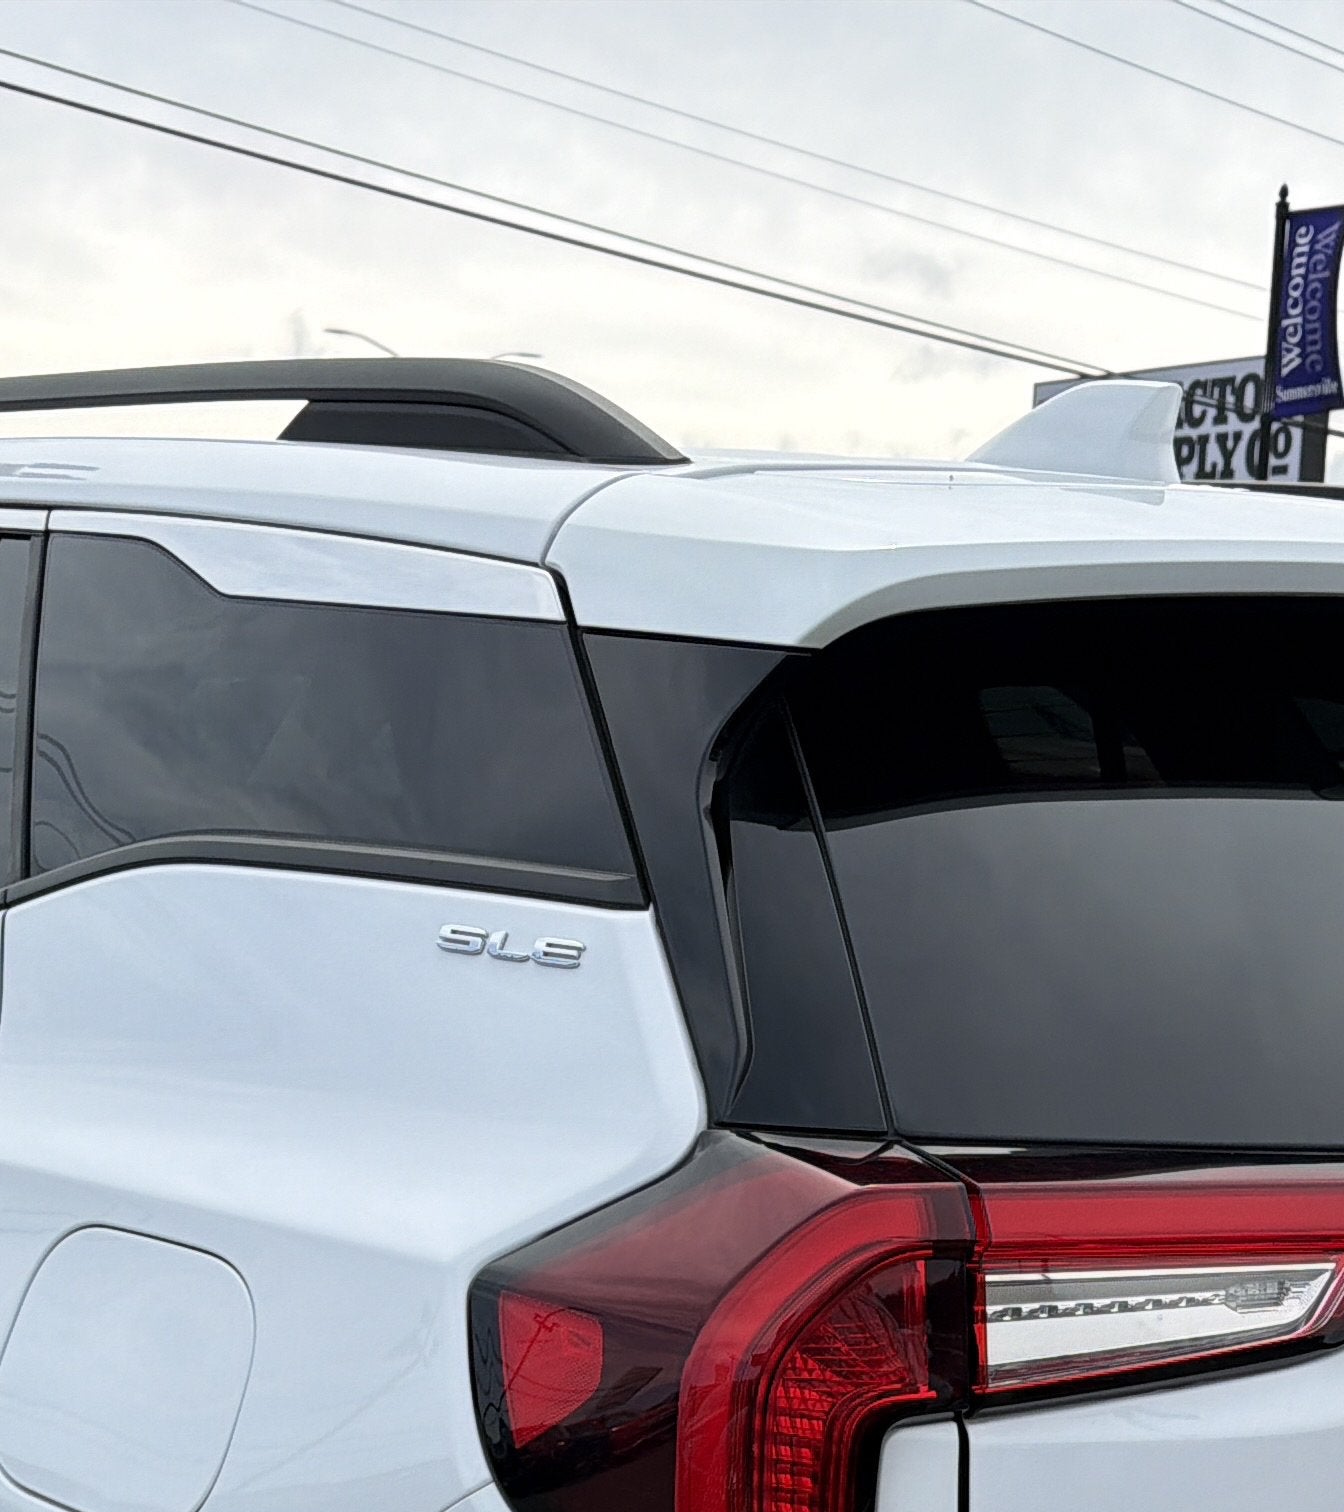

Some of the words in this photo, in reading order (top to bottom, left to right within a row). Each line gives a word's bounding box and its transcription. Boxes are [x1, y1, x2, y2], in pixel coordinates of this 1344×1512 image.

[1280, 224, 1315, 378] Welcome
[1305, 220, 1343, 373] Welcome
[436, 924, 586, 969] SLE
